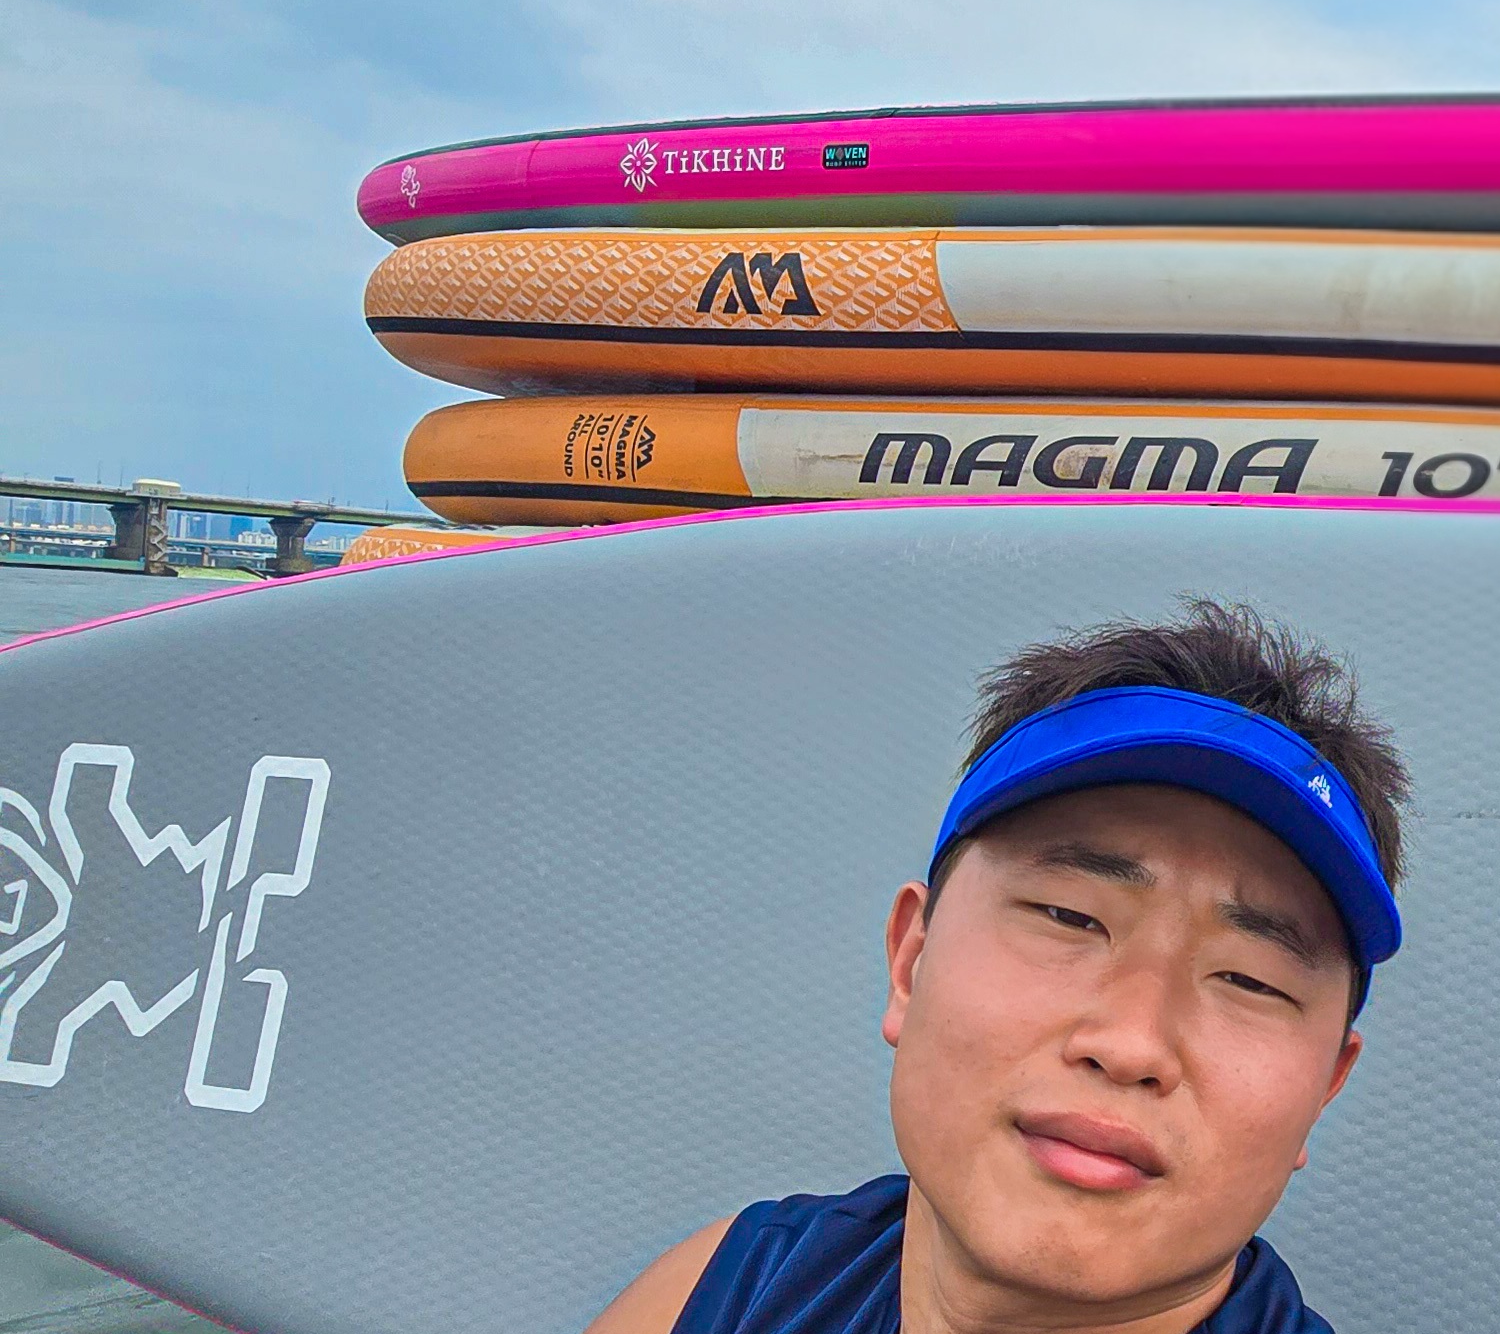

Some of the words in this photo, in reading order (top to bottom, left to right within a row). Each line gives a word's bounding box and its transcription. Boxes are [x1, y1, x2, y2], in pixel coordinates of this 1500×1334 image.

[563, 413, 586, 478] AROUND
[577, 413, 596, 438] ALL
[590, 414, 615, 479] 10'10"
[615, 414, 639, 480] MAGMA
[857, 432, 1320, 494] MAGMA
